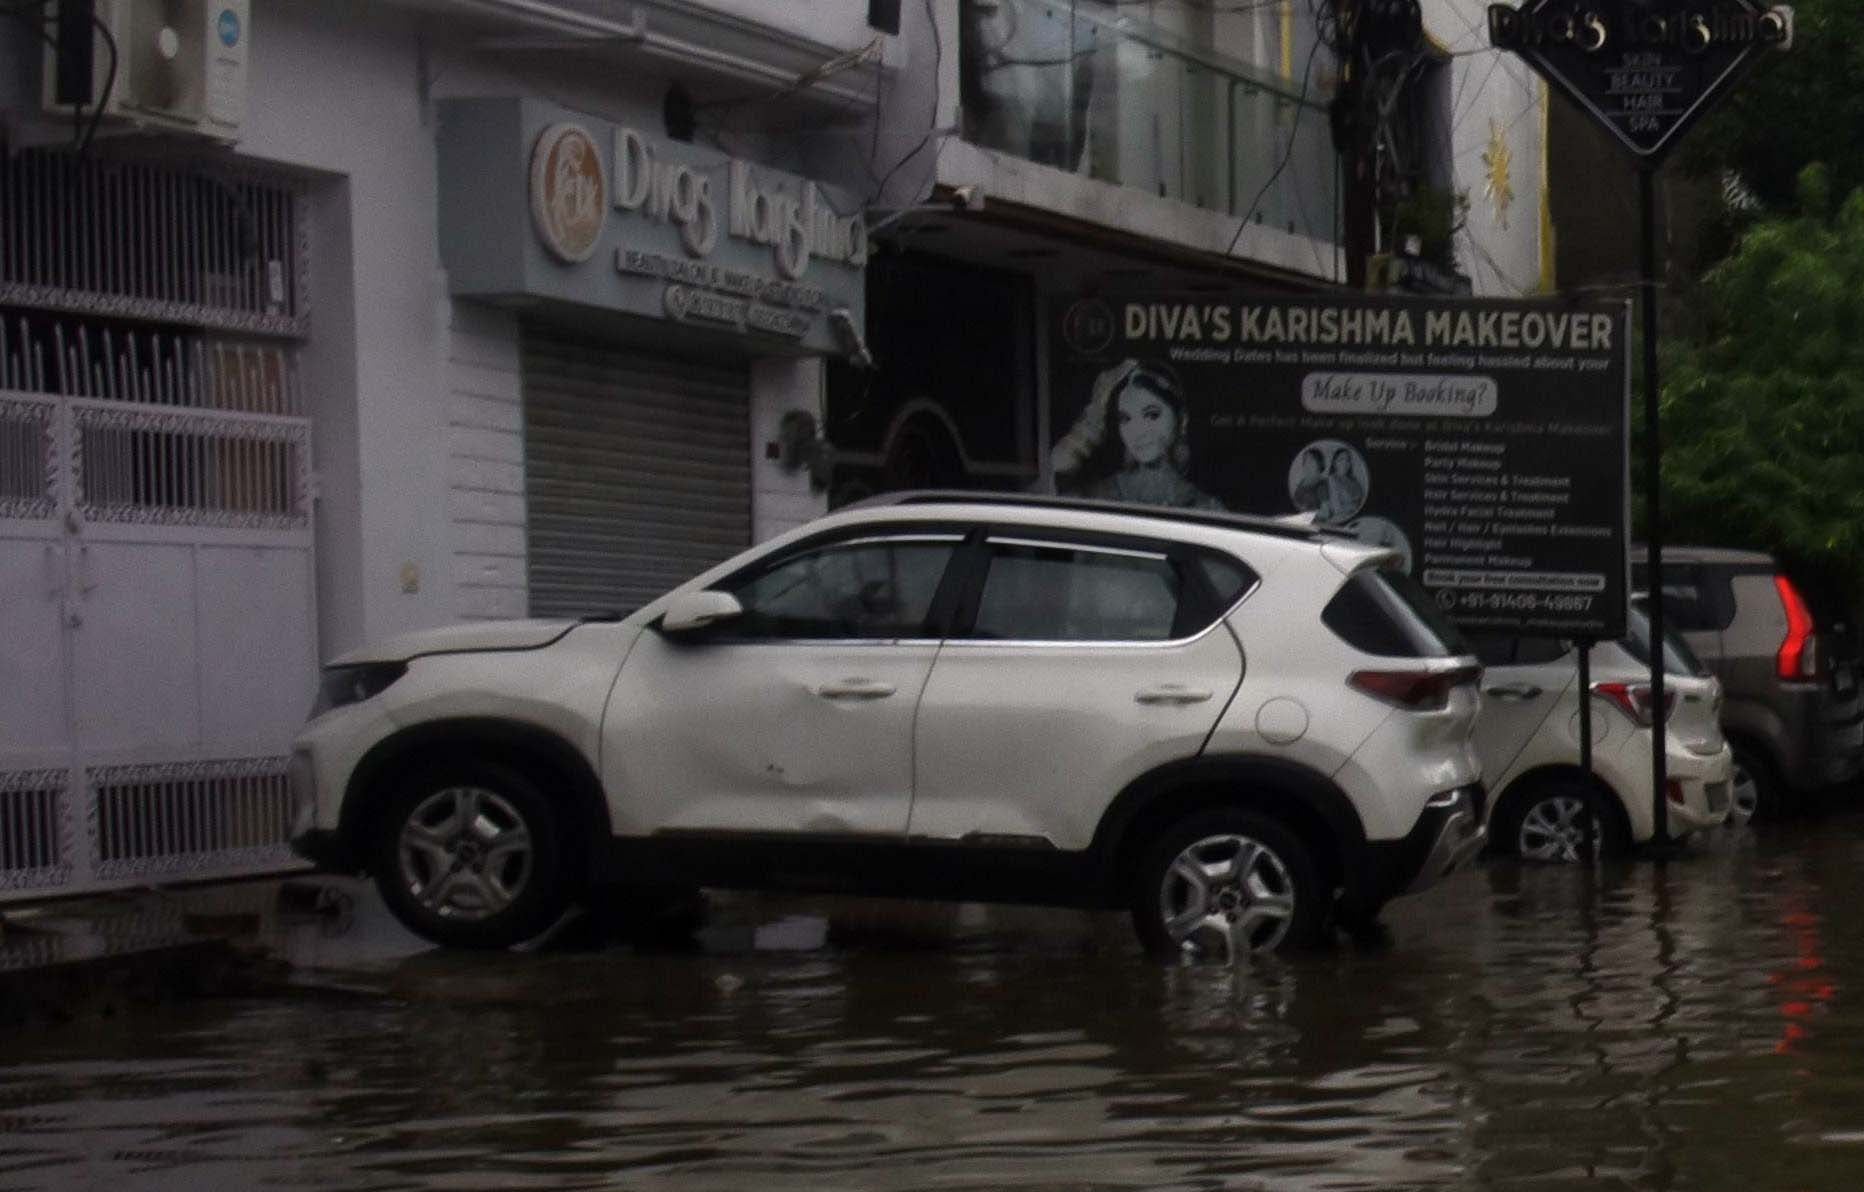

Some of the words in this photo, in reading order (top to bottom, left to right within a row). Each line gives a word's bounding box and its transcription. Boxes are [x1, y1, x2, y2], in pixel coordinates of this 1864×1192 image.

[1124, 304, 1232, 341] DIVA'S
[1240, 305, 1416, 346] KARISHMA
[1424, 308, 1613, 350] MAKEOVER
[1312, 375, 1362, 401] Make
[1369, 380, 1397, 410] Up
[1404, 378, 1488, 411] Booking?
